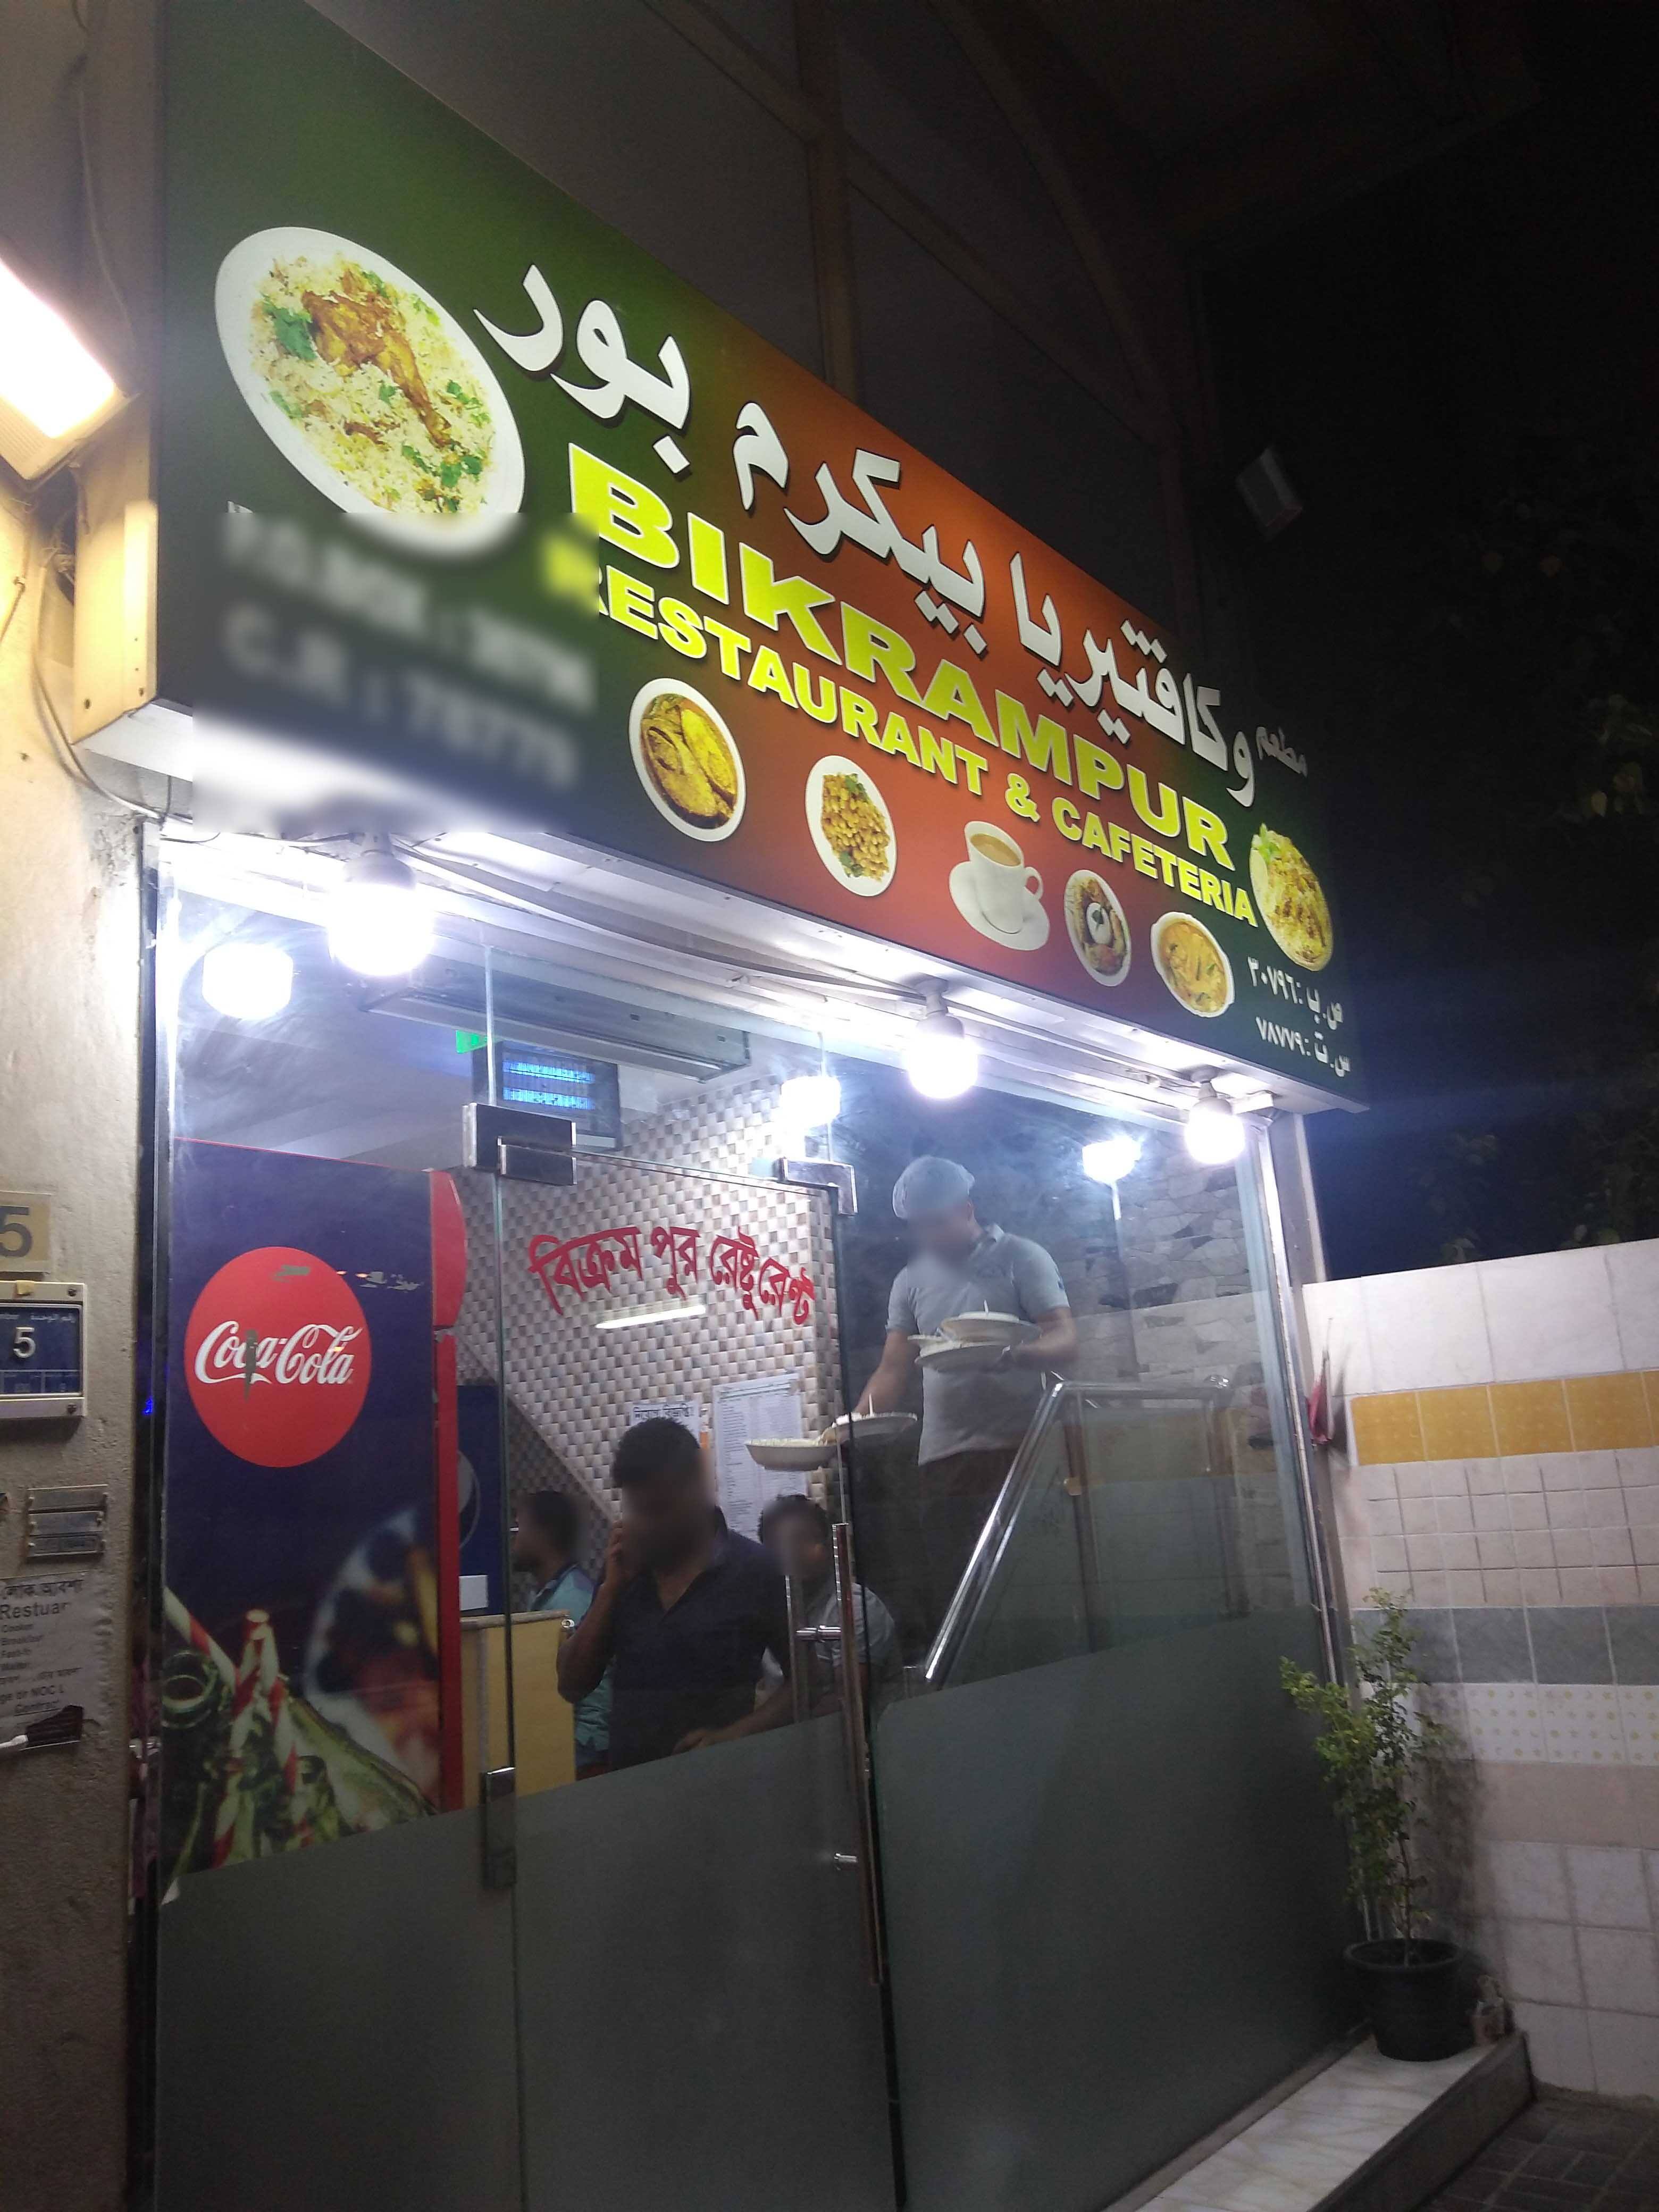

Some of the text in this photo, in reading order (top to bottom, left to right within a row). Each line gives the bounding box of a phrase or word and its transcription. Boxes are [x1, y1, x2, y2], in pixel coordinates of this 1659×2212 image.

[473, 264, 691, 474] بور
[733, 402, 987, 655] بيكرم
[544, 541, 988, 796] ESTAURANT
[1004, 772, 1041, 823] &
[1052, 795, 1258, 927] CAFETERIA
[568, 442, 1236, 871] BIKRAMPUR
[1255, 725, 1309, 778] مطعم
[13, 1327, 36, 1358] 5
[195, 1320, 363, 1385] Coca-Cola
